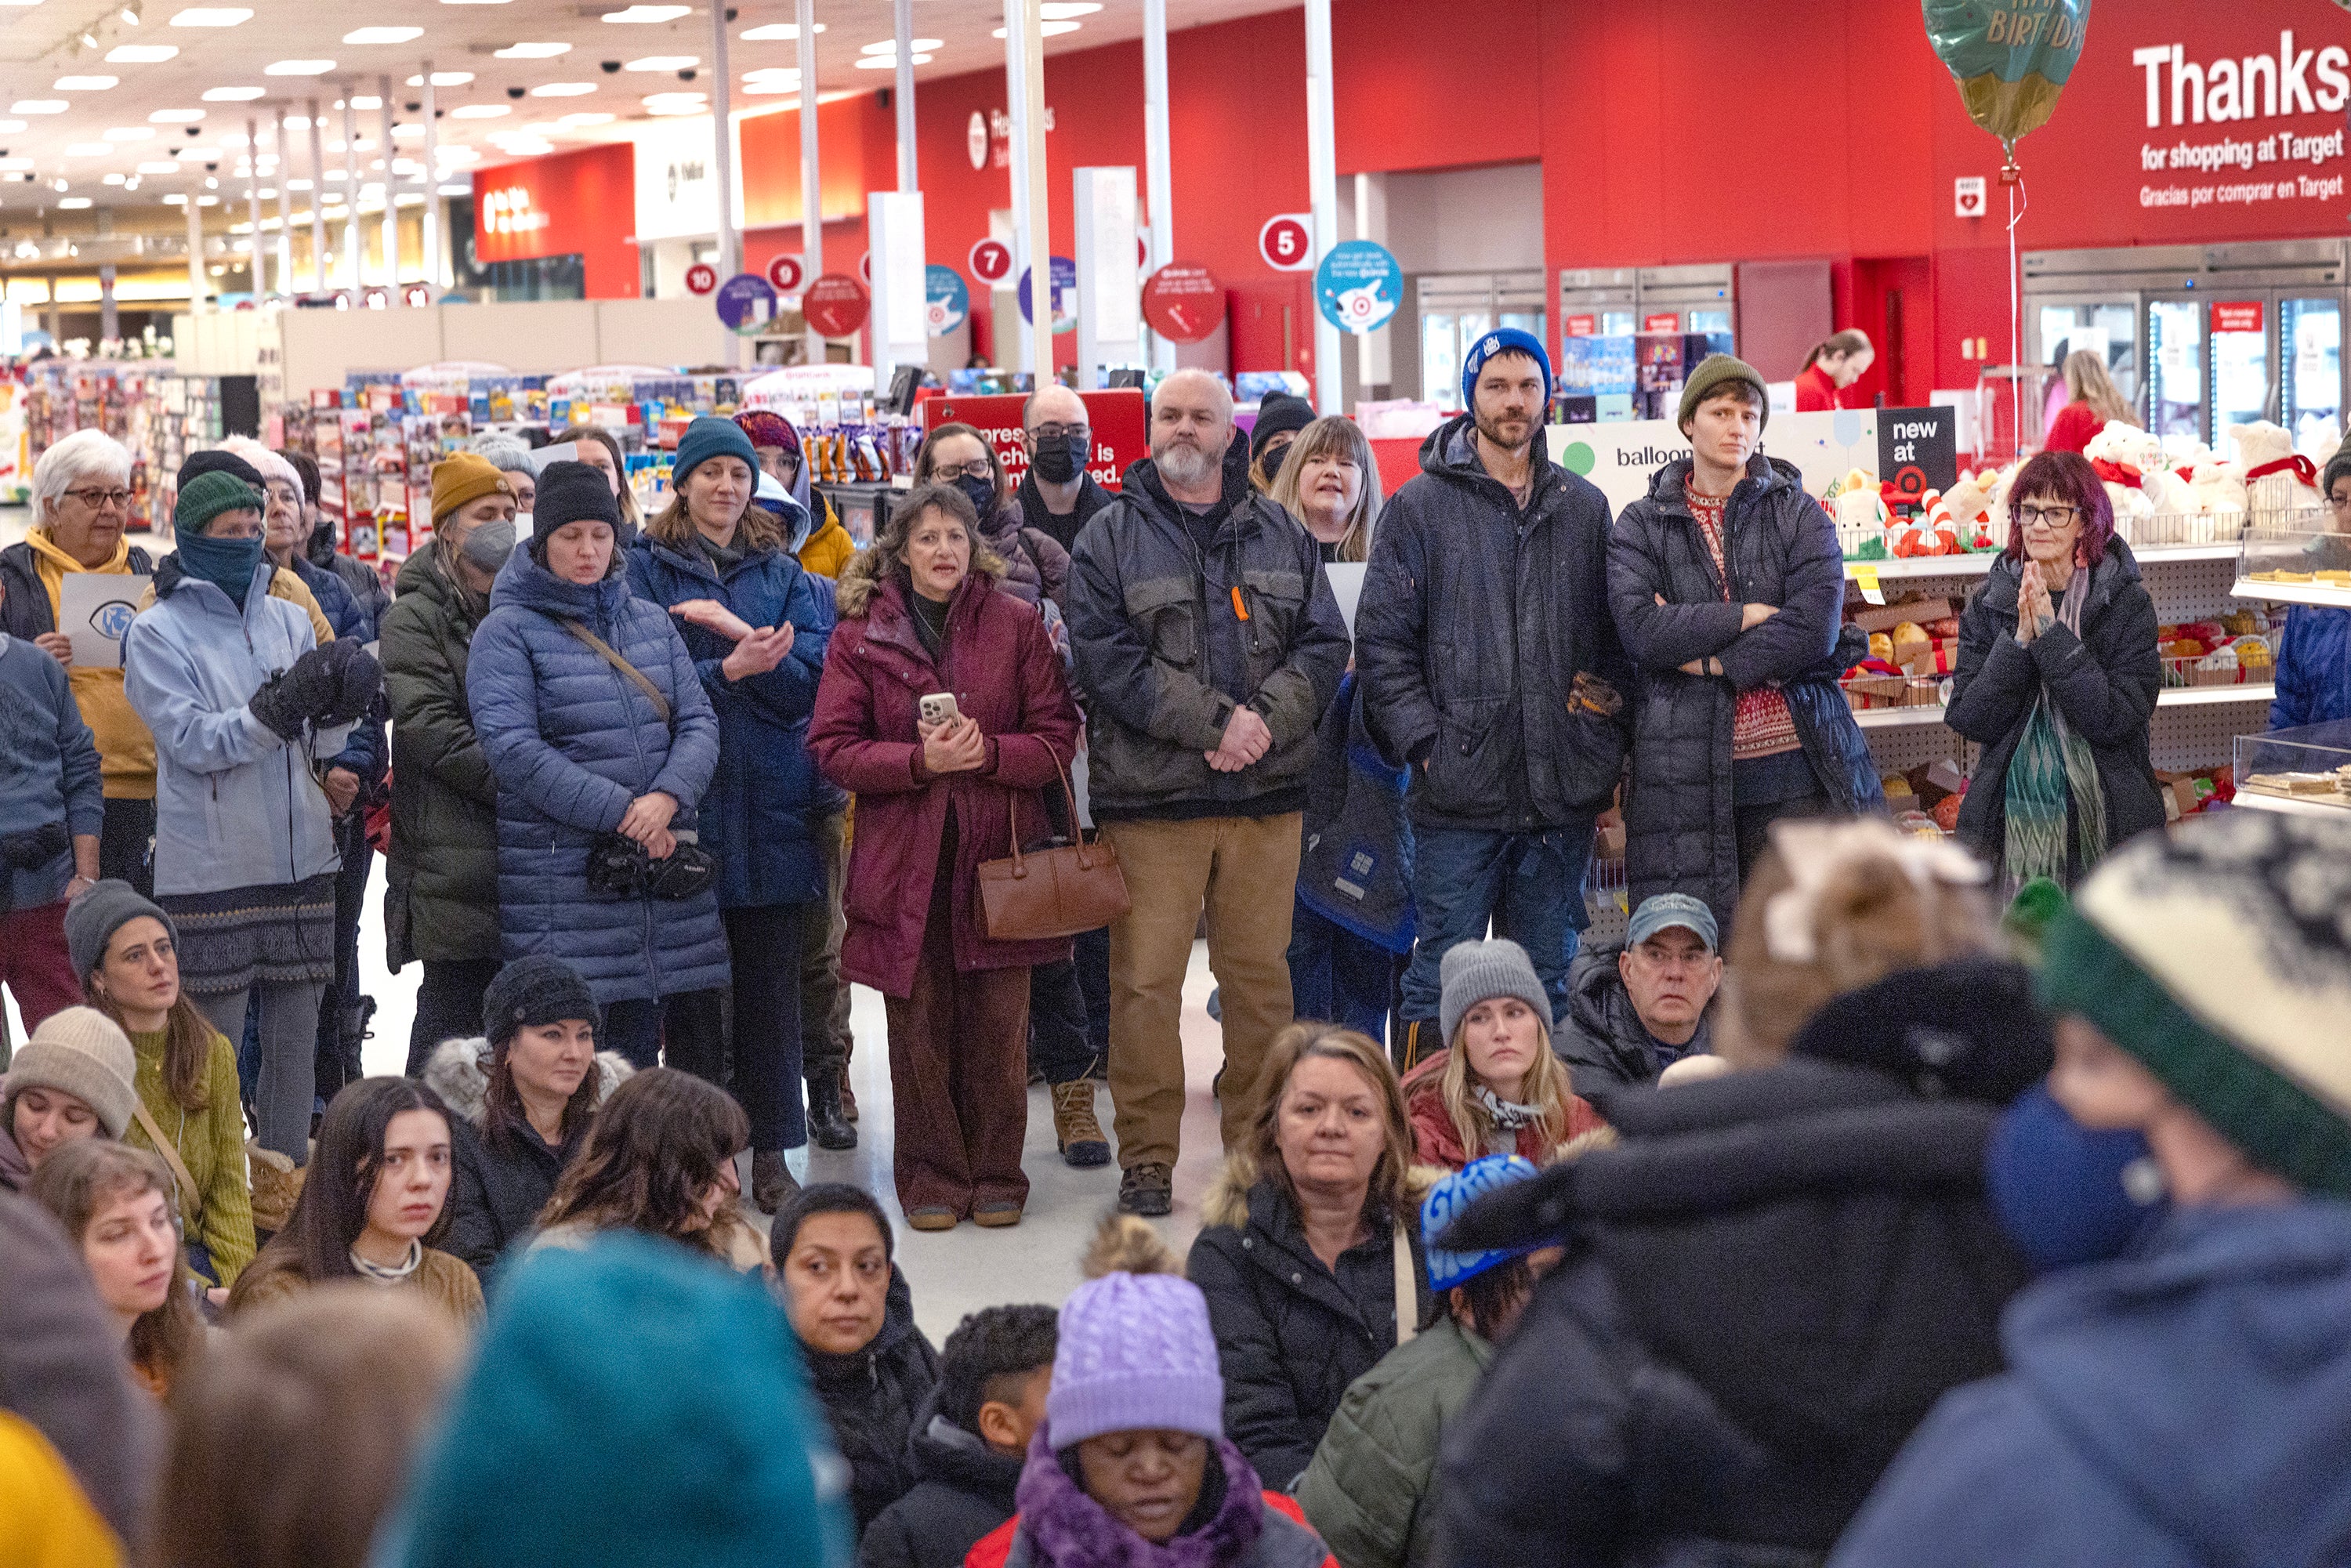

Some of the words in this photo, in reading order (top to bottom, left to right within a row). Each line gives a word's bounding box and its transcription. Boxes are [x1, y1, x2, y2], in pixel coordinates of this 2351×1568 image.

[1987, 9, 2085, 50] BIRTHDA
[2132, 29, 2350, 128] Thanks
[2141, 143, 2168, 171] for
[2169, 136, 2254, 172] shopping
[2257, 134, 2277, 161] at
[2278, 129, 2344, 165] Target
[2139, 184, 2189, 208] Gracias
[2191, 186, 2215, 208] por
[2216, 183, 2275, 205] comprar
[2277, 181, 2295, 199] en
[2298, 174, 2343, 201] Target
[1277, 230, 1295, 256] 5
[984, 249, 1000, 272] 7
[691, 271, 712, 288] 10
[980, 427, 1024, 444] pres
[1893, 421, 1938, 440] new
[1097, 442, 1114, 462] is
[1893, 441, 1916, 462] at
